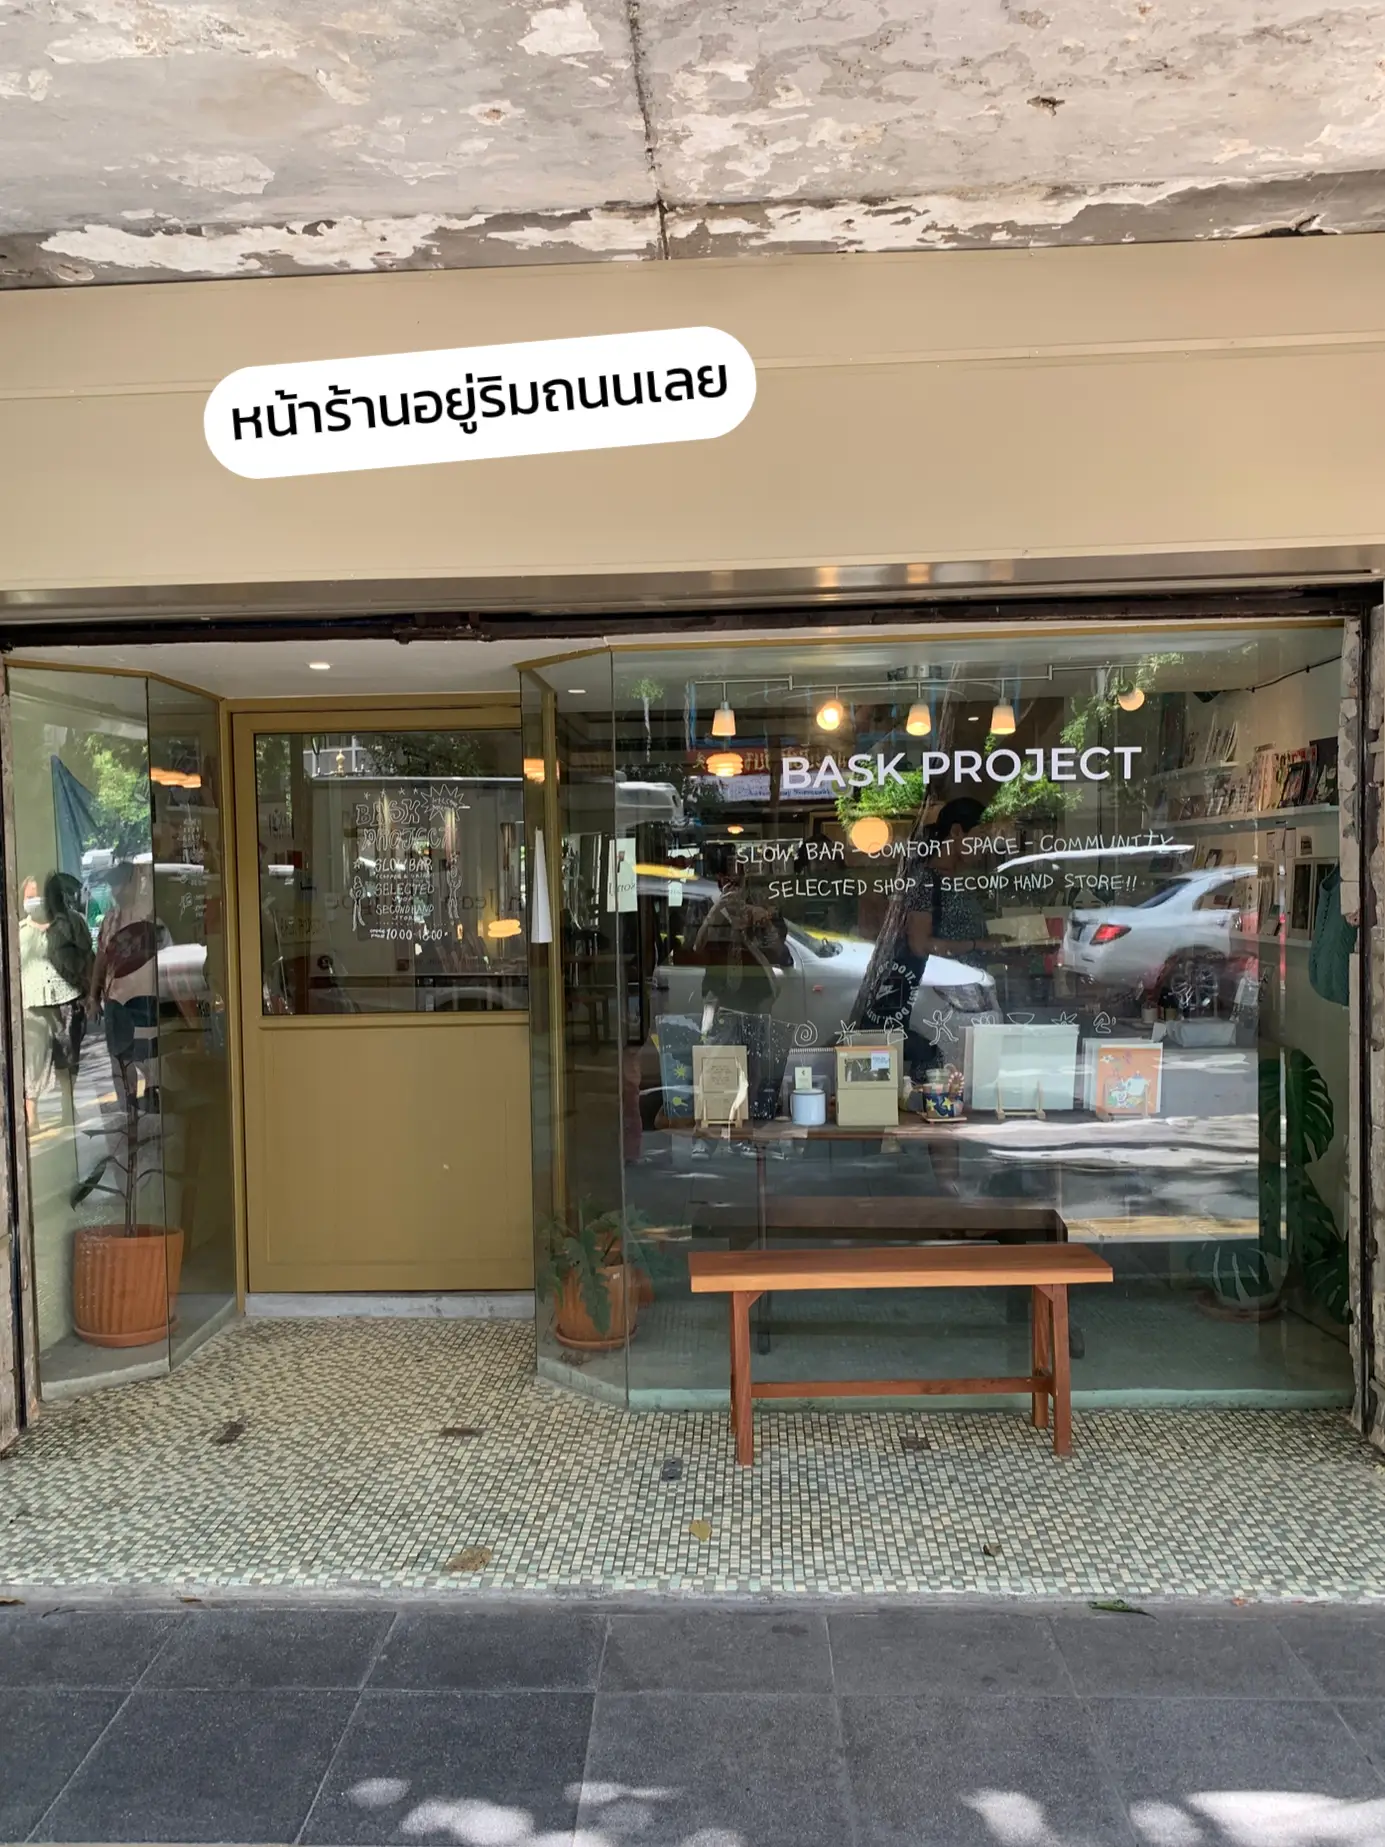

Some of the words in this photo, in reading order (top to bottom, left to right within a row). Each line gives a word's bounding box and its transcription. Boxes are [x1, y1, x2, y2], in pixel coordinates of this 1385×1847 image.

[782, 752, 907, 790] BASK
[922, 746, 1142, 785] PROJECT
[806, 841, 845, 861] BAR
[867, 838, 955, 860] COMFORT
[960, 836, 1020, 855] SPACE
[1040, 829, 1174, 854] COMMUNITY
[375, 882, 435, 896] SELECTED
[768, 878, 867, 900] SELECTED
[873, 877, 916, 896] SHOP
[940, 875, 1009, 893] SECOND
[1014, 873, 1054, 891] HAND
